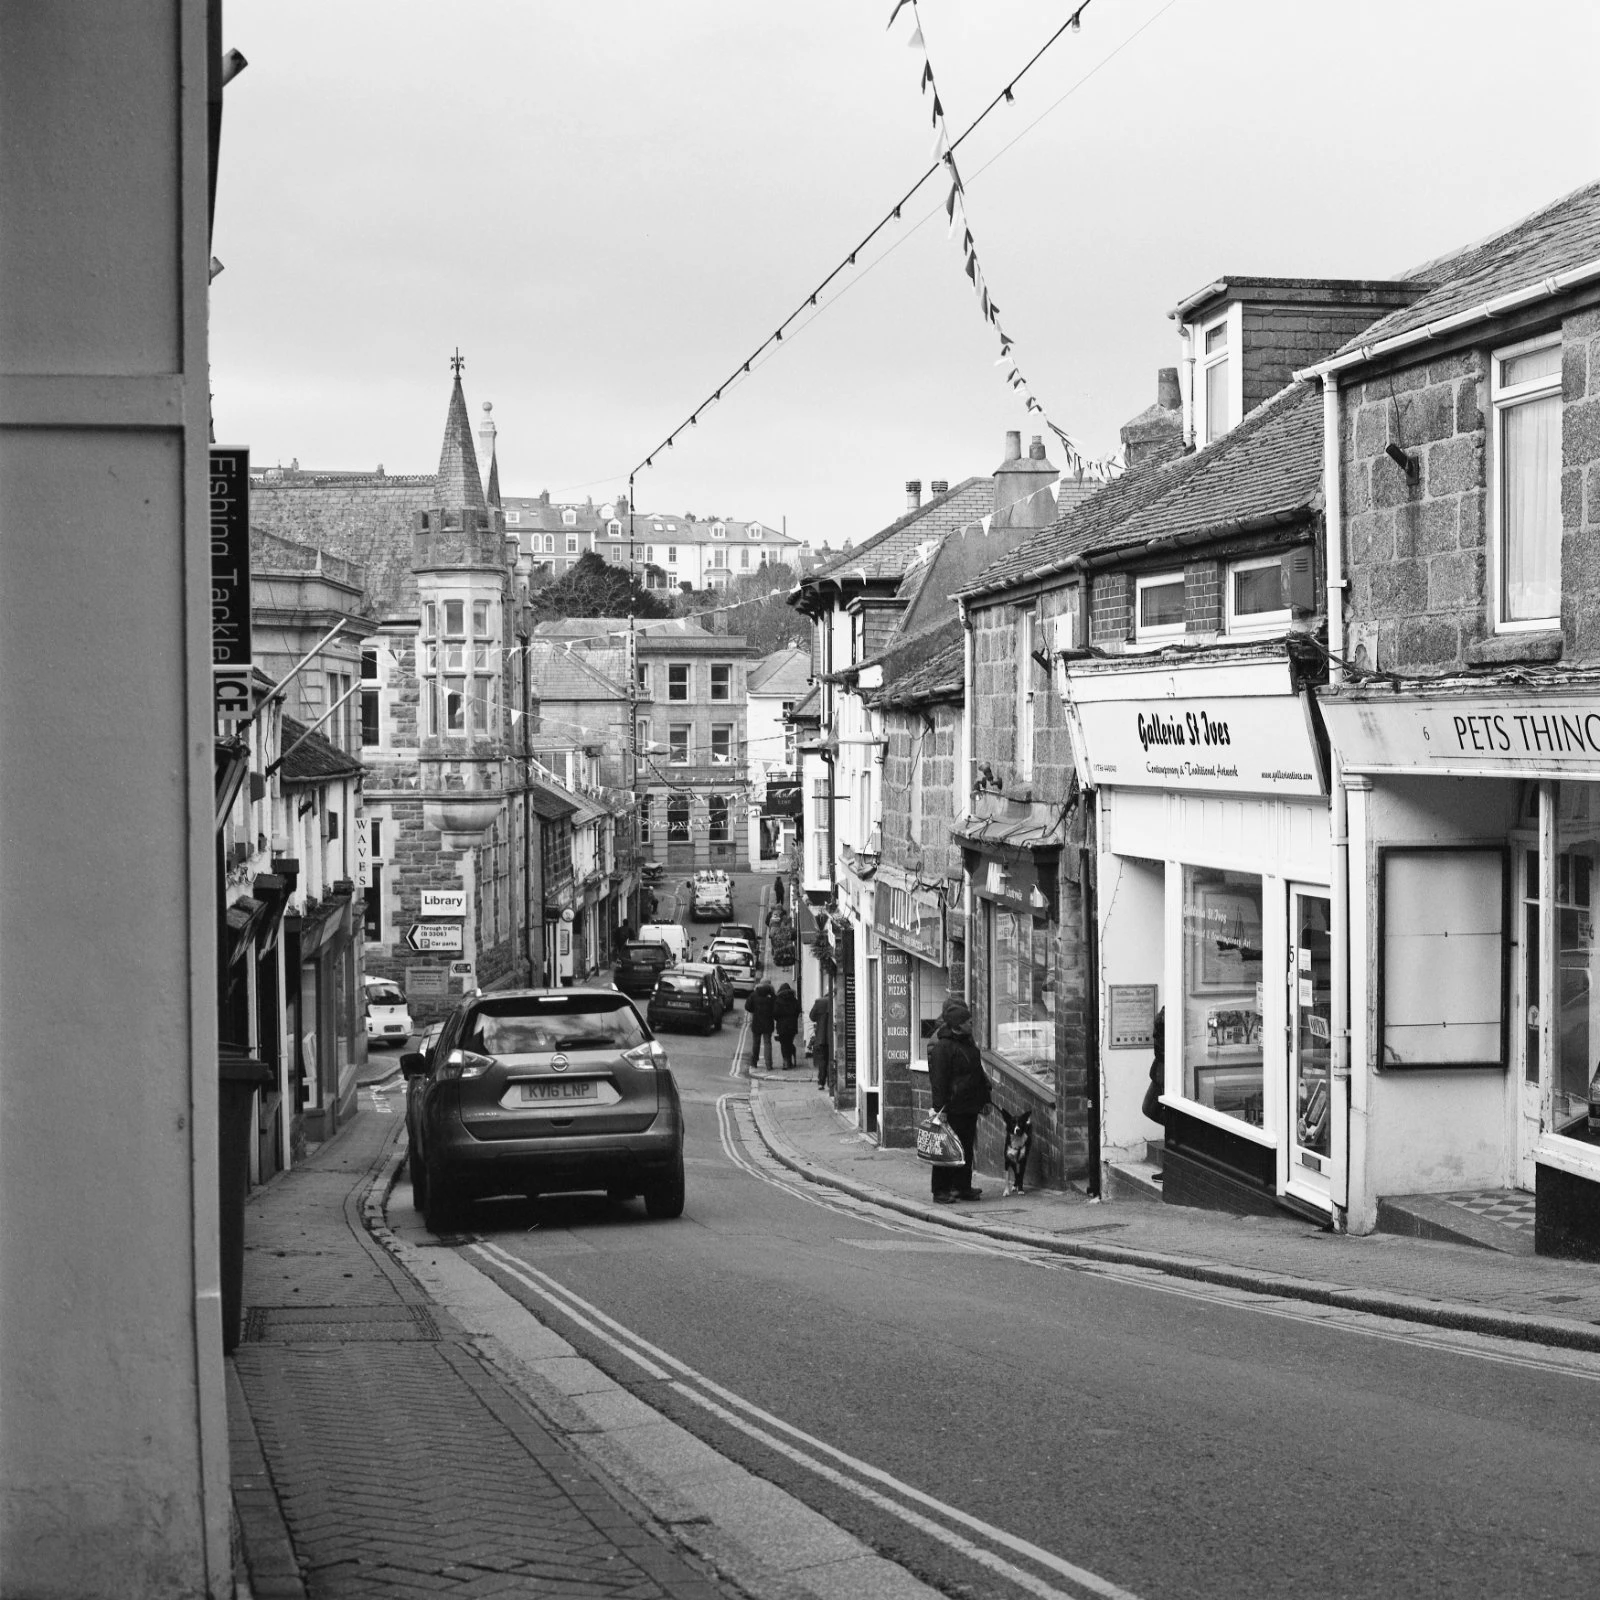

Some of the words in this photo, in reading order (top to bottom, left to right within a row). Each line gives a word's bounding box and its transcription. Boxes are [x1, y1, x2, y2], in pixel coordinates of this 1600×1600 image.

[209, 456, 236, 556] Fishing
[211, 568, 239, 661] Tackle
[1138, 712, 1185, 752] Galleria
[1186, 711, 1200, 745] St
[1201, 710, 1231, 746] Ives
[1422, 726, 1430, 741] 6
[1453, 715, 1511, 751] PETS
[1146, 760, 1180, 779] Contemporary
[1184, 761, 1216, 776] Traditional
[1216, 763, 1239, 779] Artwork
[356, 819, 368, 886] WAVES
[424, 895, 463, 907] Library
[1289, 946, 1295, 963] 5
[887, 974, 908, 984] SPECIAL
[888, 985, 907, 995] PIZZAS
[887, 1026, 909, 1036] BURGERS
[1310, 1017, 1327, 1037] OPEN
[887, 1049, 909, 1060] CHICKEN
[529, 1084, 560, 1098] KV16
[563, 1083, 589, 1097] LNP
